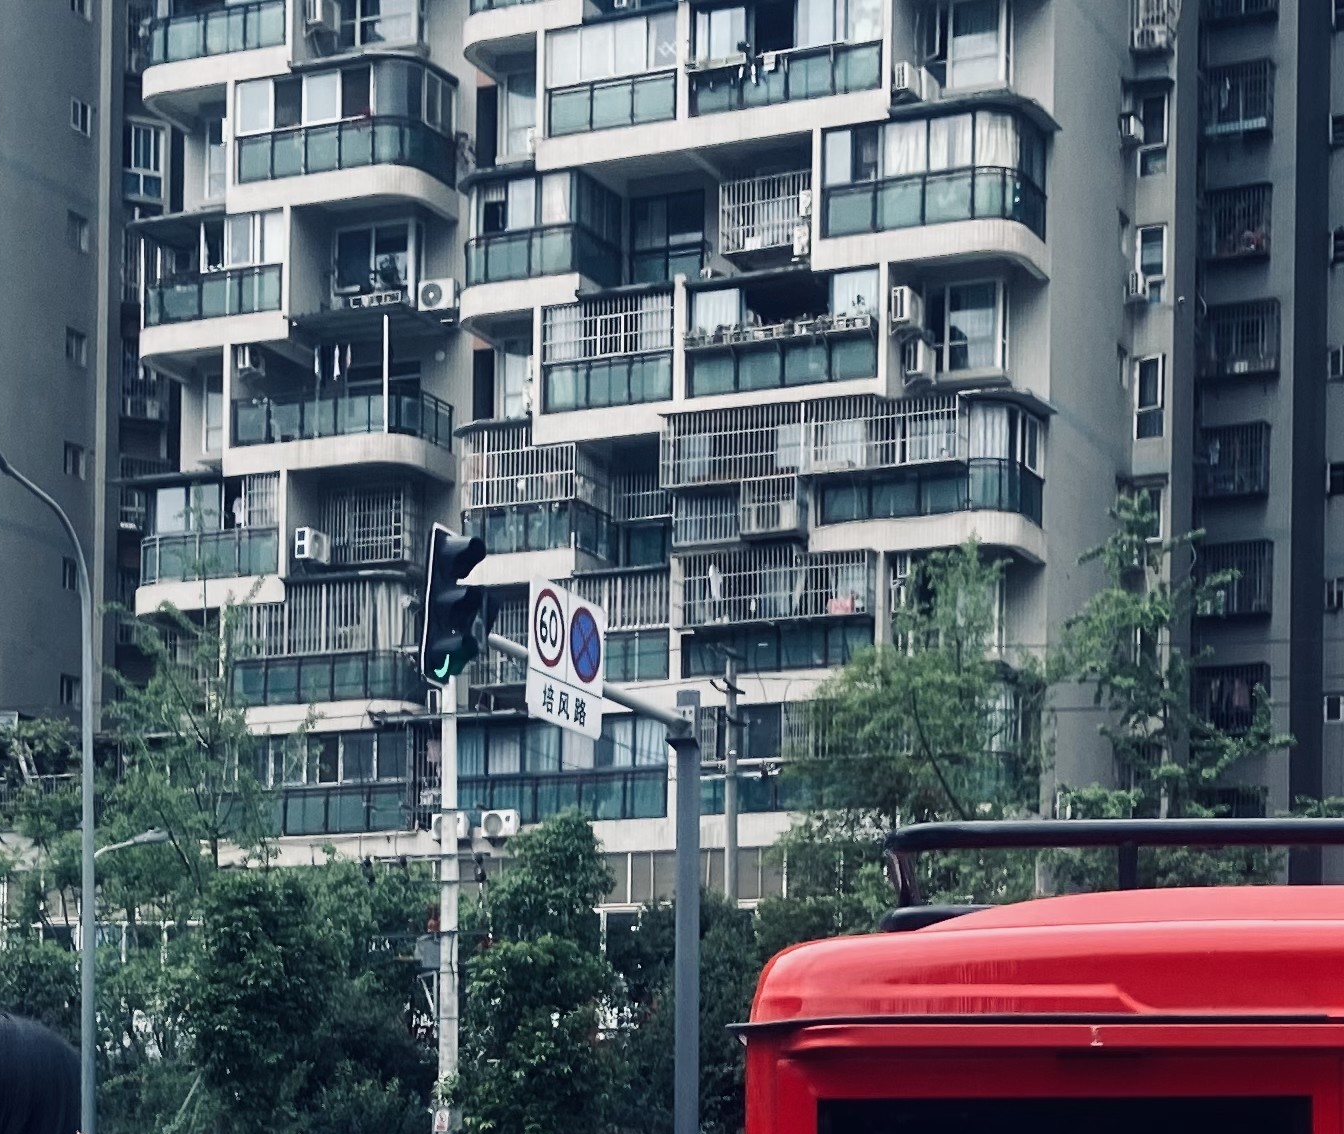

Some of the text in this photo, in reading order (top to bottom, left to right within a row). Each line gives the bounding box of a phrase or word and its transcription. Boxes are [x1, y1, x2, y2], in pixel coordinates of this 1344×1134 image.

[539, 605, 558, 648] 60
[542, 683, 587, 728] 培风路
